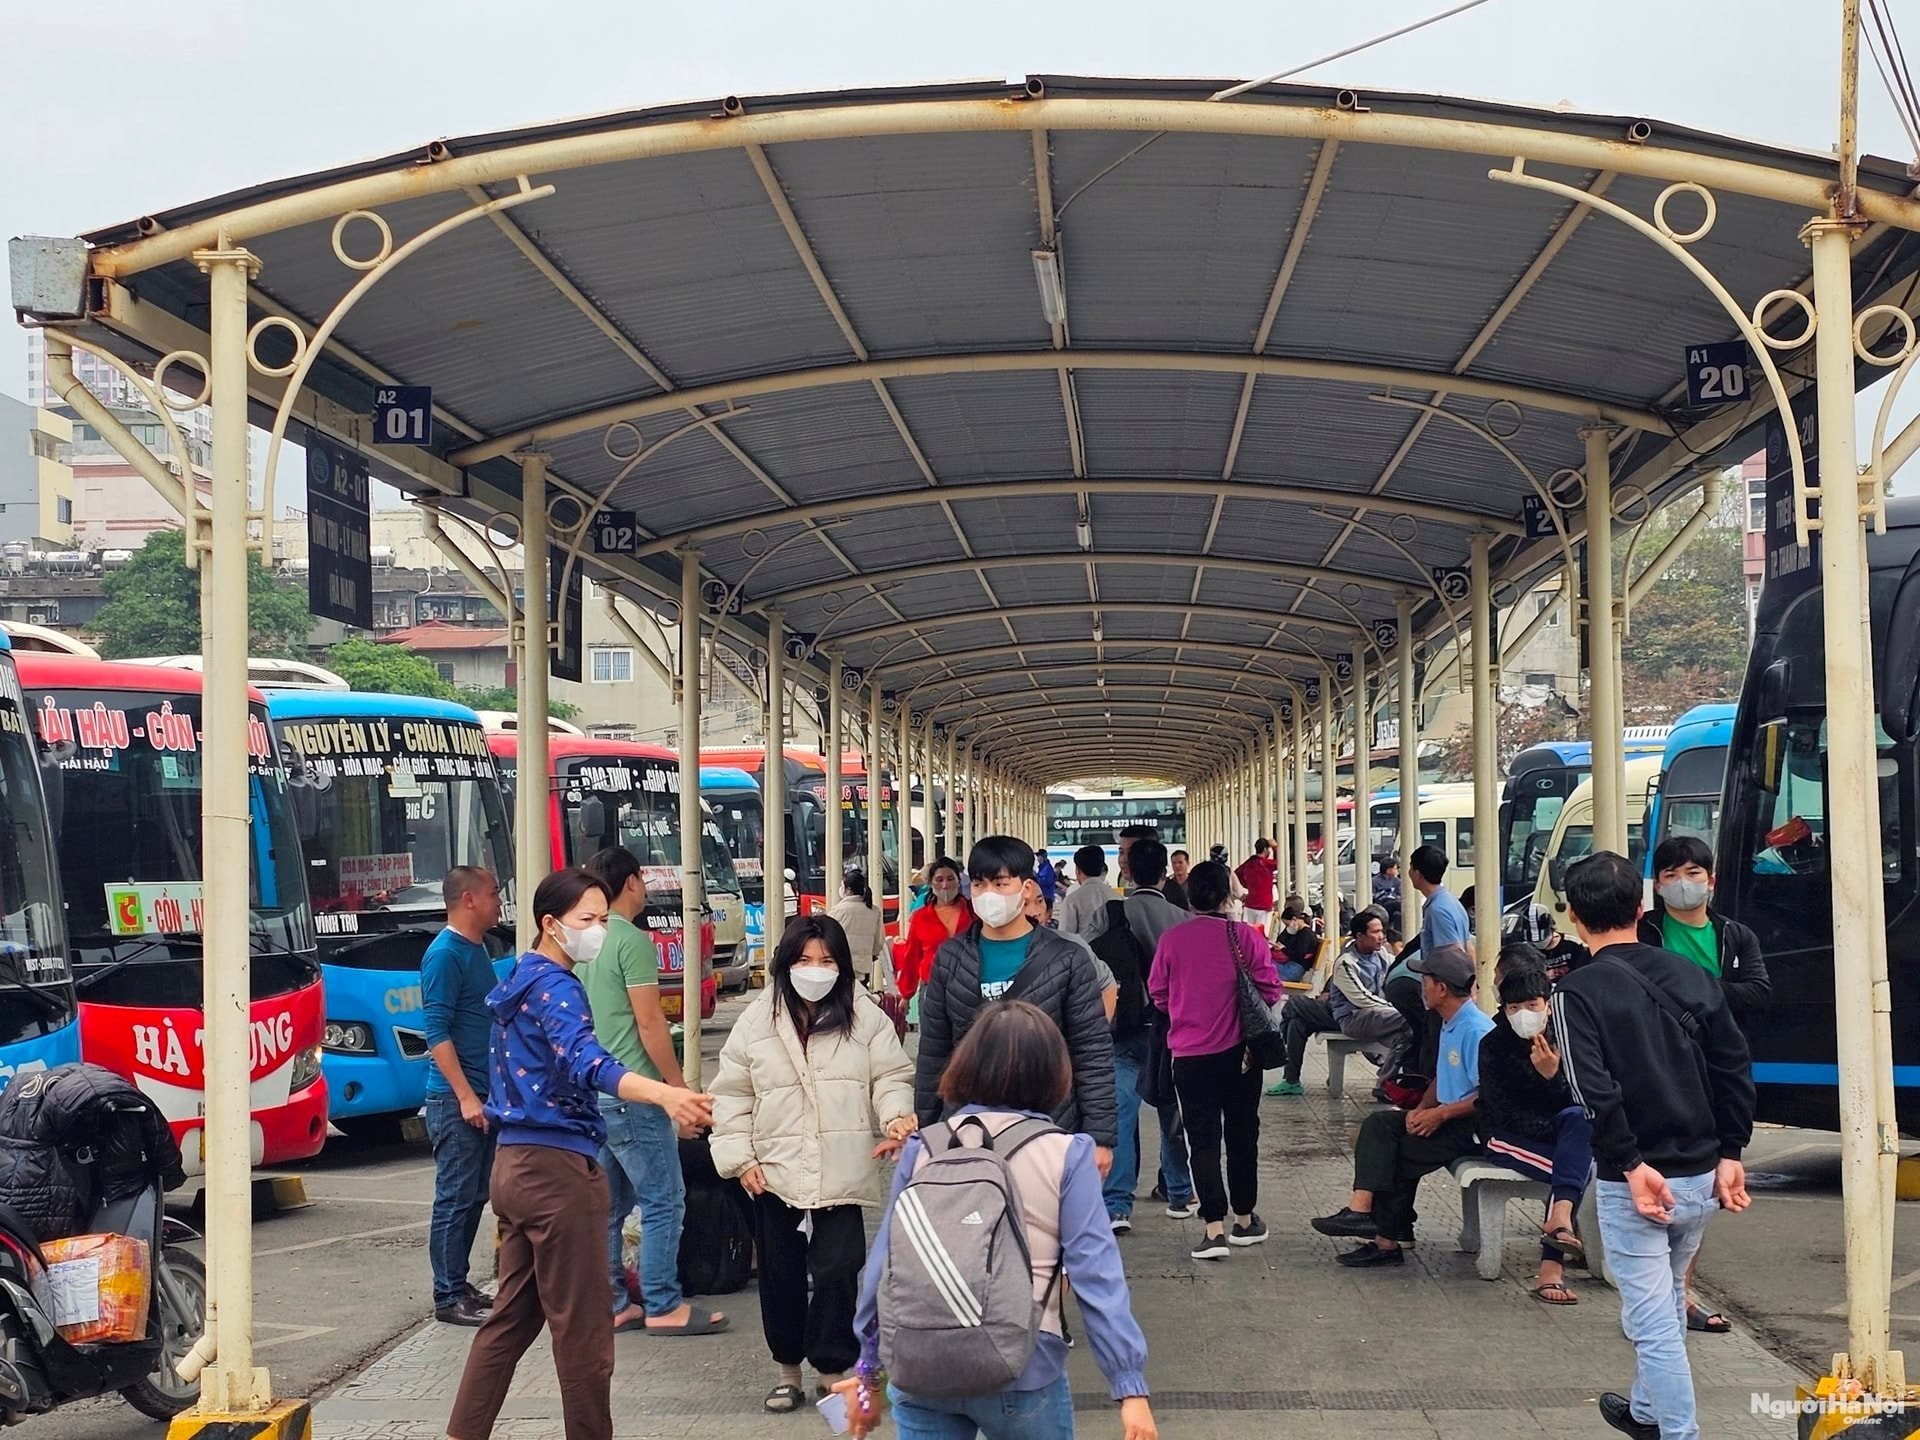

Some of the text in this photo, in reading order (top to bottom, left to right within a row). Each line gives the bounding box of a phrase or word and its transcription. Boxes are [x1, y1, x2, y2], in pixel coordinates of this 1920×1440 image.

[1690, 349, 1708, 363] A1
[1699, 364, 1744, 399] 20
[377, 391, 396, 404] A2
[386, 408, 424, 439] 01
[1526, 498, 1539, 509] A1
[597, 514, 611, 525] A2
[602, 527, 632, 550] 02
[75, 701, 130, 757] HẬU
[147, 701, 197, 751] CỒN
[369, 717, 391, 752] LÝ
[403, 718, 451, 754] CHÙA
[448, 721, 489, 758] VÀNG
[362, 757, 385, 778] MẠC
[154, 887, 183, 933] CỒN
[314, 911, 339, 933] VĨNH
[132, 1016, 191, 1076] HÀ
